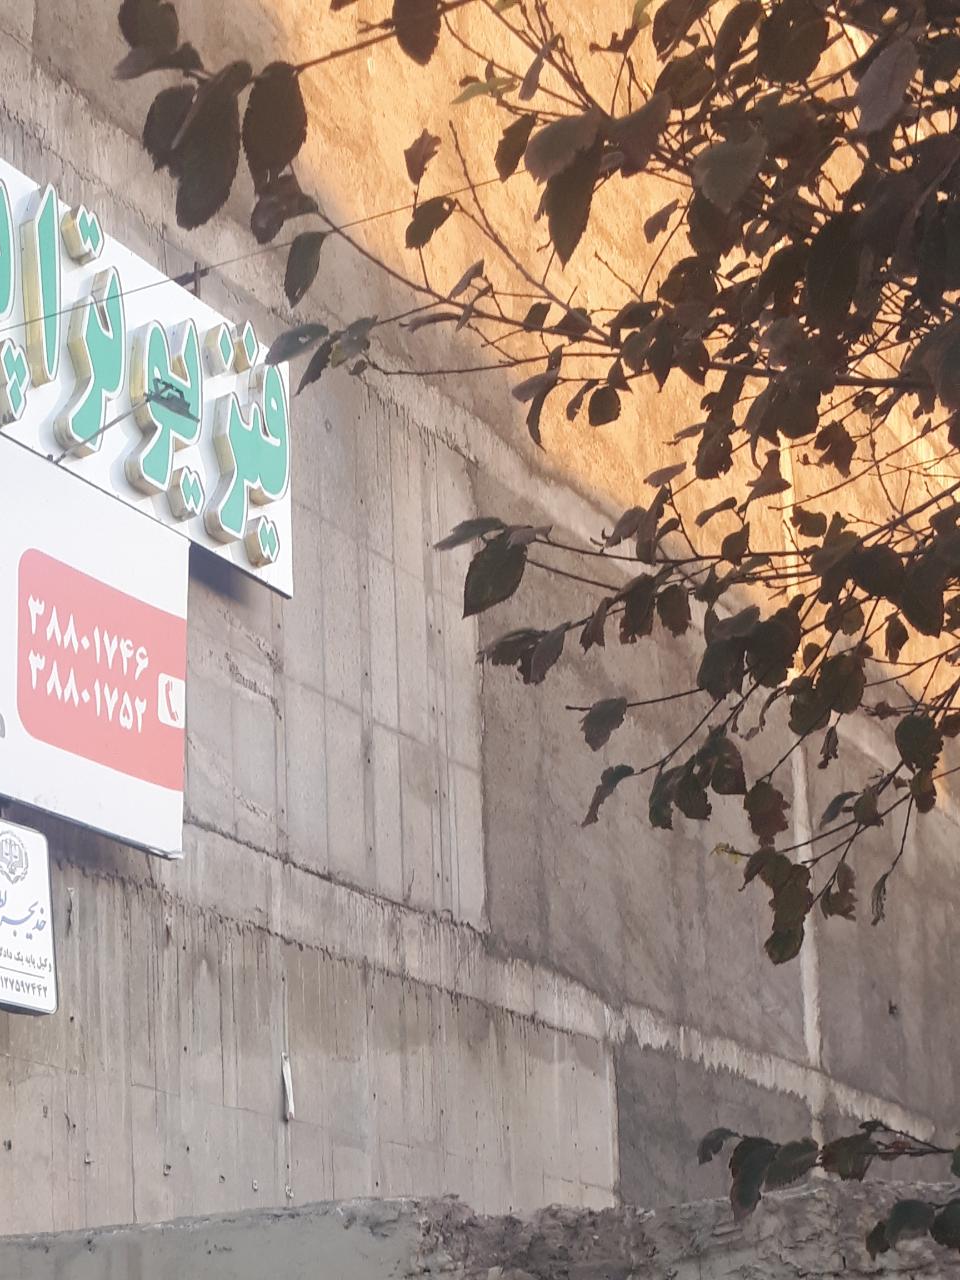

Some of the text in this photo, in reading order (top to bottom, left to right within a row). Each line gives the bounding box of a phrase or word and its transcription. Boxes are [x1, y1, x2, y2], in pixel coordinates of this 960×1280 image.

[28, 595, 149, 681] ۳۸۸۰۱۷۴۶
[28, 650, 147, 733] ۳۸۸۰۱۷۵۲
[0, 900, 47, 940] خدیجه
[14, 951, 24, 966] یک
[25, 954, 36, 969] پایه
[36, 956, 52, 973] وکیل
